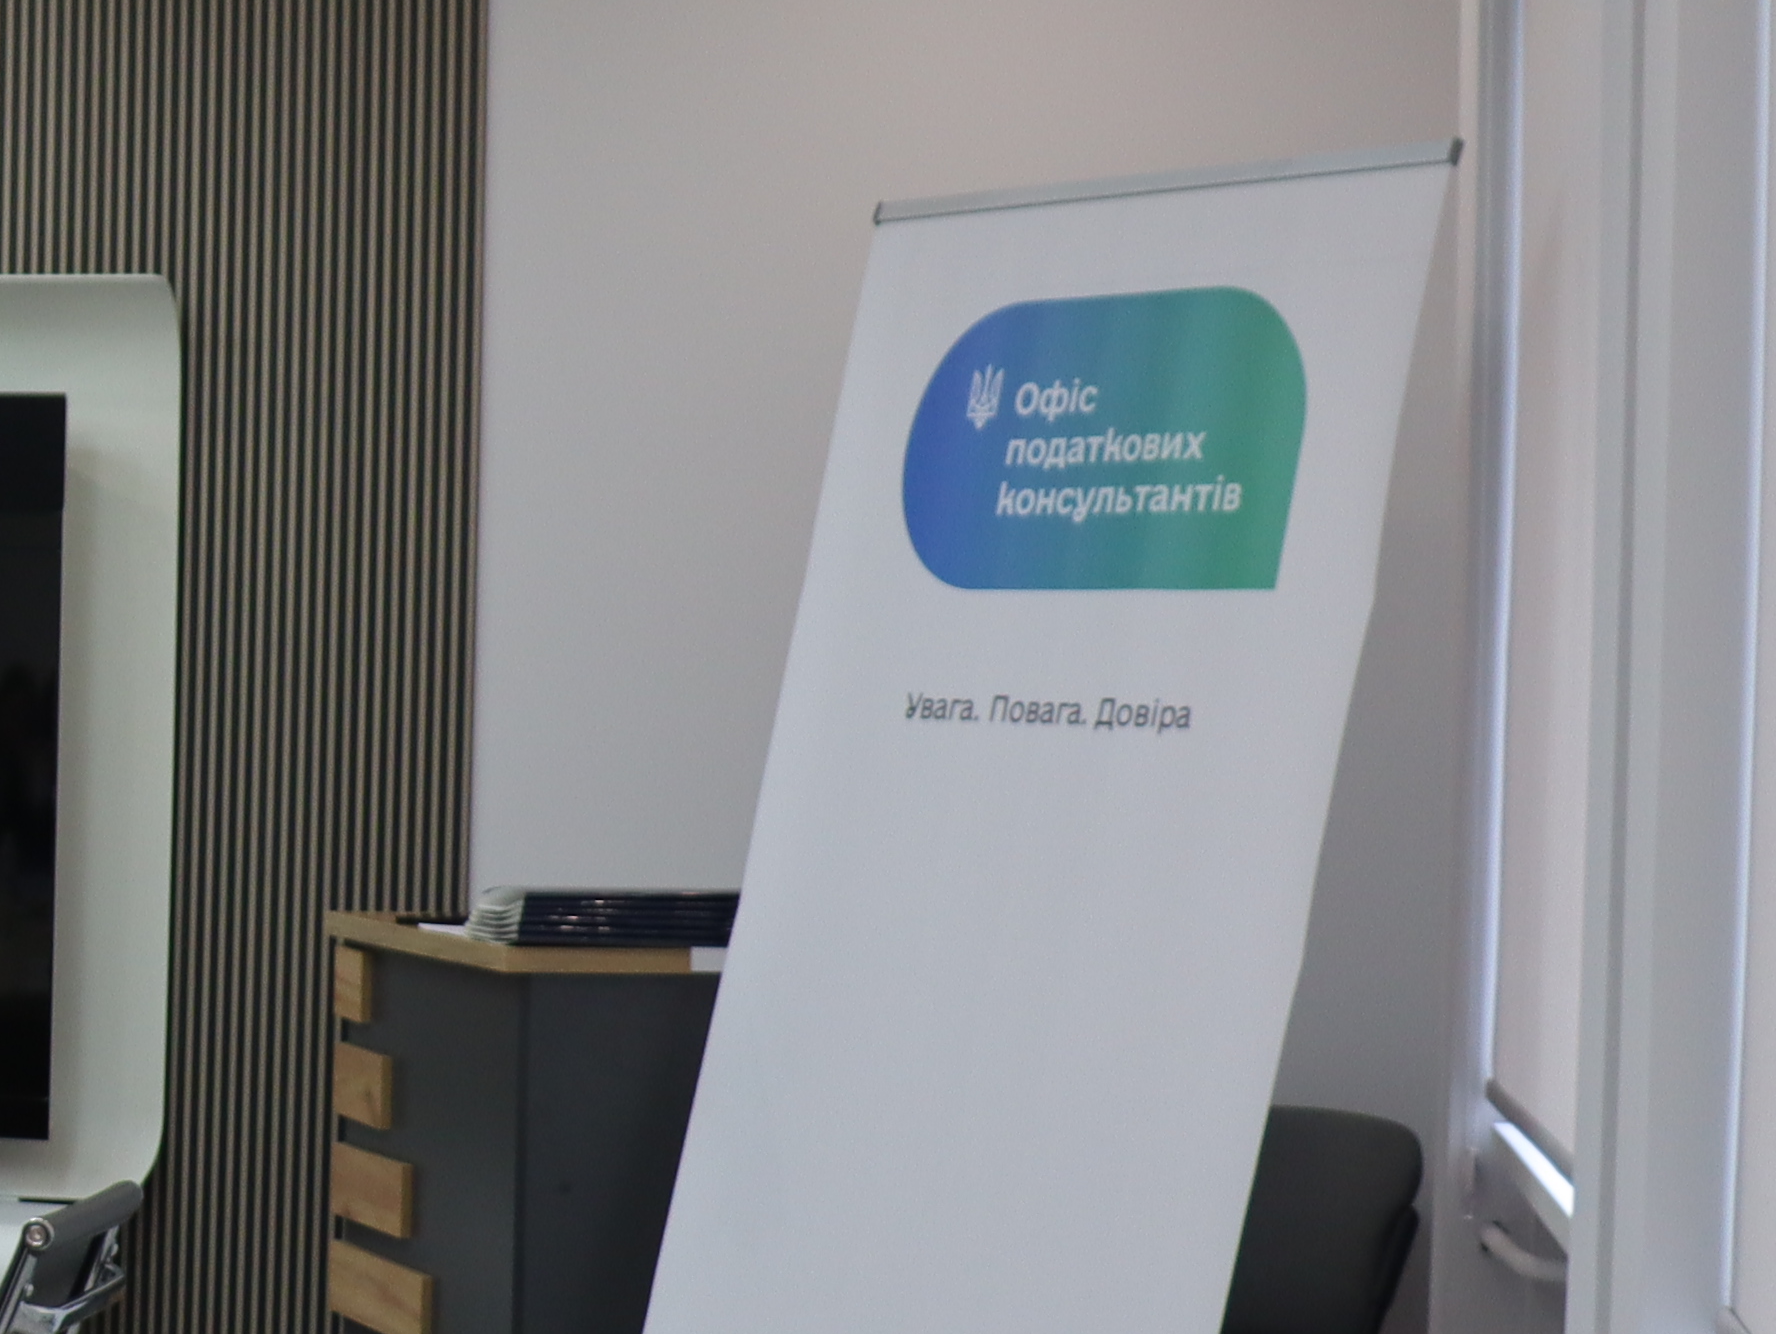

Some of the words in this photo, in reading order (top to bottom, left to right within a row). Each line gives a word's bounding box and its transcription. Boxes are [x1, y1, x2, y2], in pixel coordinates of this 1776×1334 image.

[1014, 378, 1099, 424] Офіс
[1004, 427, 1208, 470] податкових
[995, 474, 1243, 524] консультантів
[905, 691, 979, 721] Увага.
[989, 694, 1087, 725] Повага.
[1094, 697, 1192, 734] Довіра
